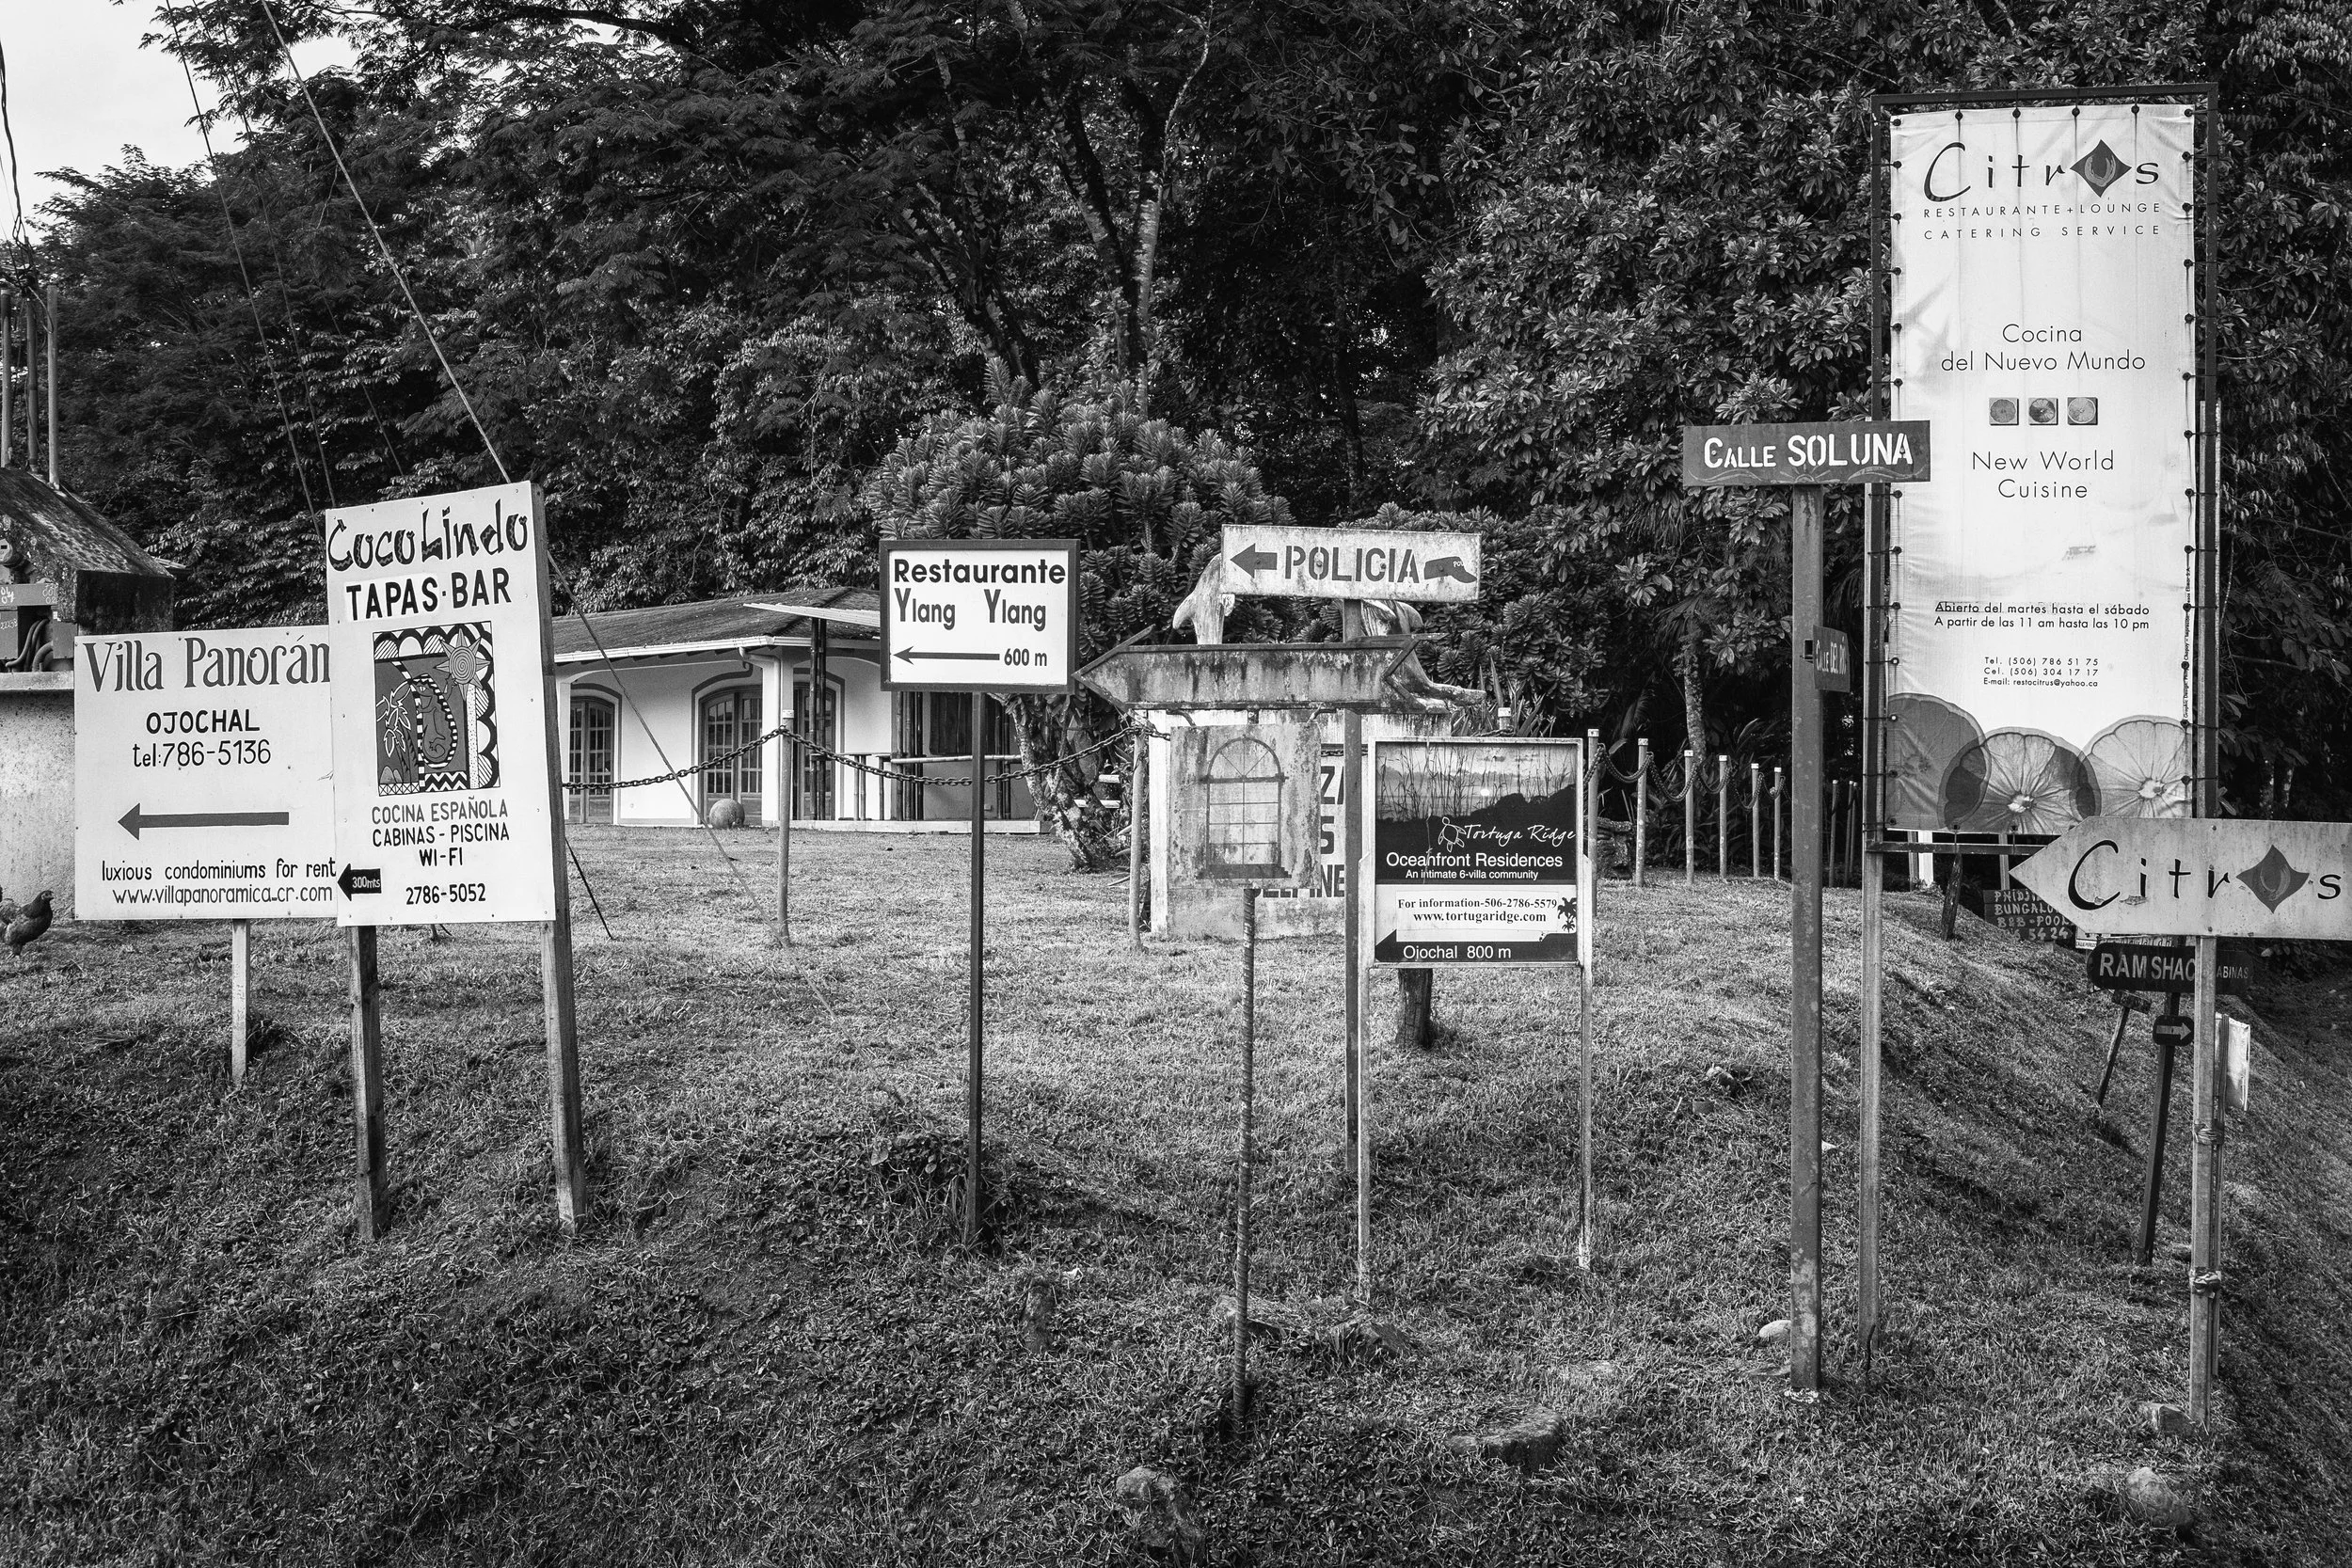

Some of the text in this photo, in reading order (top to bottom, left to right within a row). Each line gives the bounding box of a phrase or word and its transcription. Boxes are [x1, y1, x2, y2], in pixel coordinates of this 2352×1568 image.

[1924, 225, 2159, 240] CATERING SERVICE
[2002, 324, 2082, 342] Cocina
[1941, 349, 2146, 371] del Nuevo Mundo
[1704, 436, 1776, 468] CALLE
[1972, 450, 2114, 470] New World
[1998, 479, 2088, 499] Cuisine
[894, 559, 1066, 584] Restaurante
[1284, 545, 1420, 584] POLICIA
[894, 588, 1046, 631] Ylang Ylang
[1934, 602, 2150, 615] Abierto del martes hasta el sábado
[1934, 616, 2149, 631] A partir de las 11 am hasta las 10 pm
[83, 640, 165, 692] Villa
[1004, 648, 1047, 666] 600 m
[1984, 657, 2002, 665] Tel.
[2009, 657, 2036, 666] (506)
[1983, 667, 2004, 675] Cel.
[2010, 668, 2037, 676] (506)
[2069, 668, 2080, 676] 17
[1983, 677, 2098, 688] E-mail: restocitrus@yahoo.ca
[146, 709, 260, 735] OJOCHAL
[372, 796, 508, 824] COCINA ESPAÑOLA
[373, 826, 435, 847] CABINAS
[451, 822, 510, 843] PISCINA
[1464, 824, 1576, 847] Tortuga Ridge
[420, 847, 463, 866] WI-FI
[1386, 852, 1563, 867] Oceanfront Residences
[102, 857, 336, 881] luxious condominiums for rent
[1406, 869, 1539, 880] An intimate 6-villa community
[405, 882, 486, 905] 2786-5052
[1398, 899, 1416, 909] For
[1994, 903, 2058, 915] BUNGALO
[1413, 911, 1547, 924] www.tortugaridge.com
[1403, 945, 1511, 960] Ojochal 800 m
[2216, 965, 2249, 979] ABINAS
